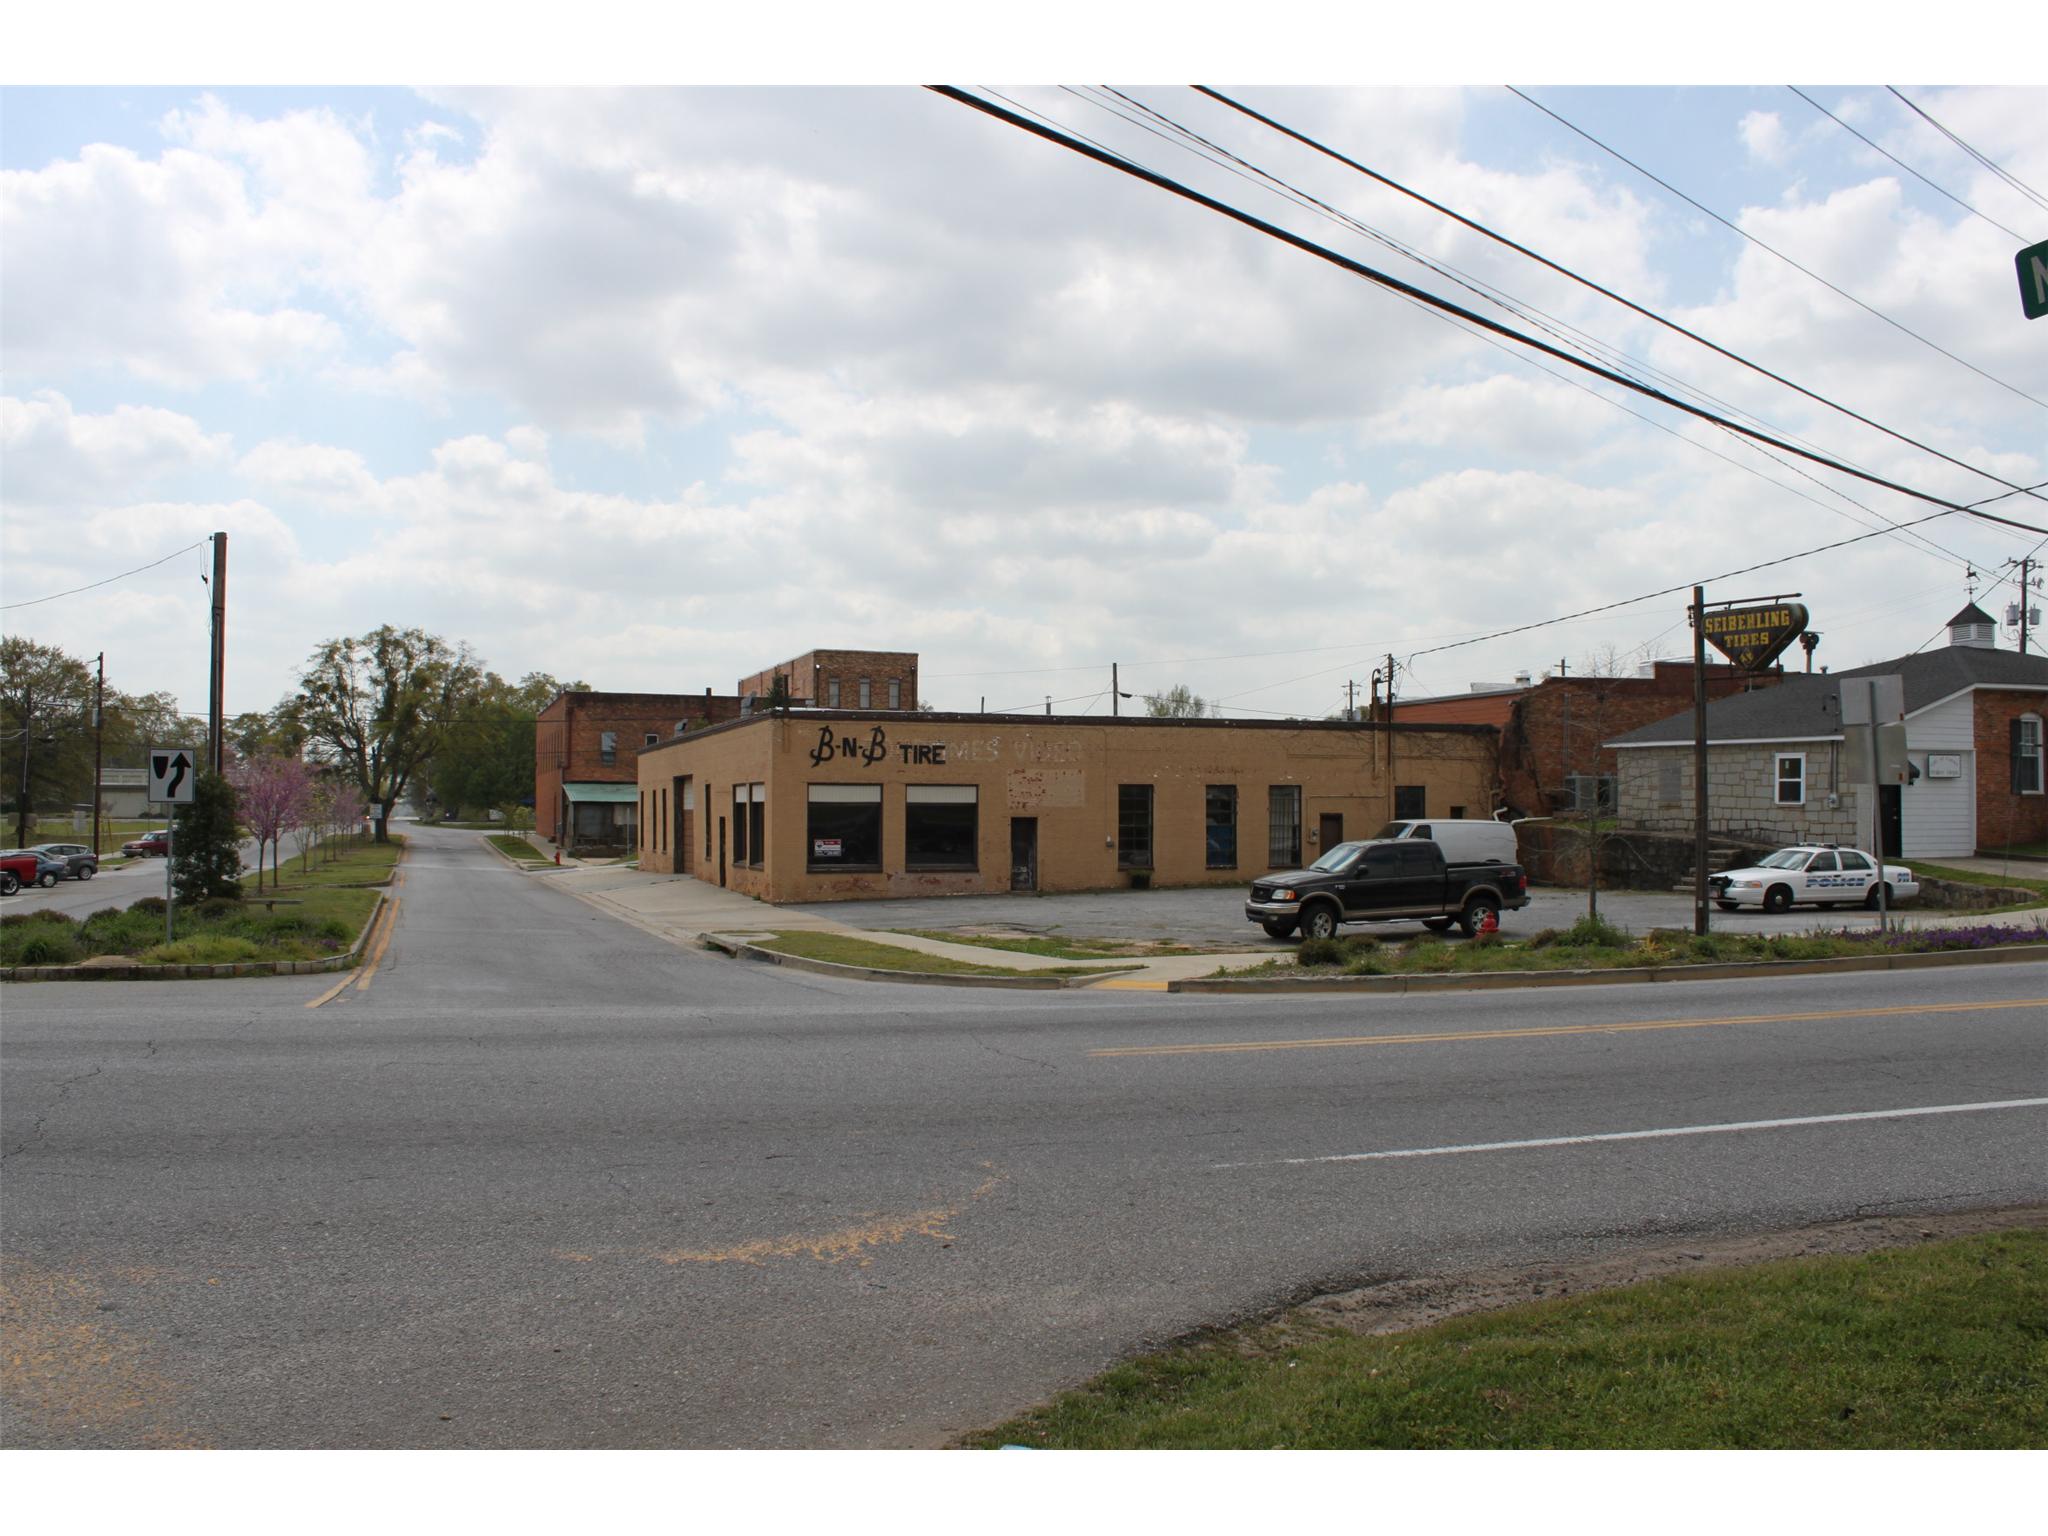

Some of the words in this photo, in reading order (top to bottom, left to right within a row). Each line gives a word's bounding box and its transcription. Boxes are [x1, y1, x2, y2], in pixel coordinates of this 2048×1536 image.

[1705, 610, 1790, 633] SEIBERLING
[1724, 632, 1770, 648] TIRES
[899, 744, 946, 765] TIRE
[1805, 877, 1866, 888] POLICE
